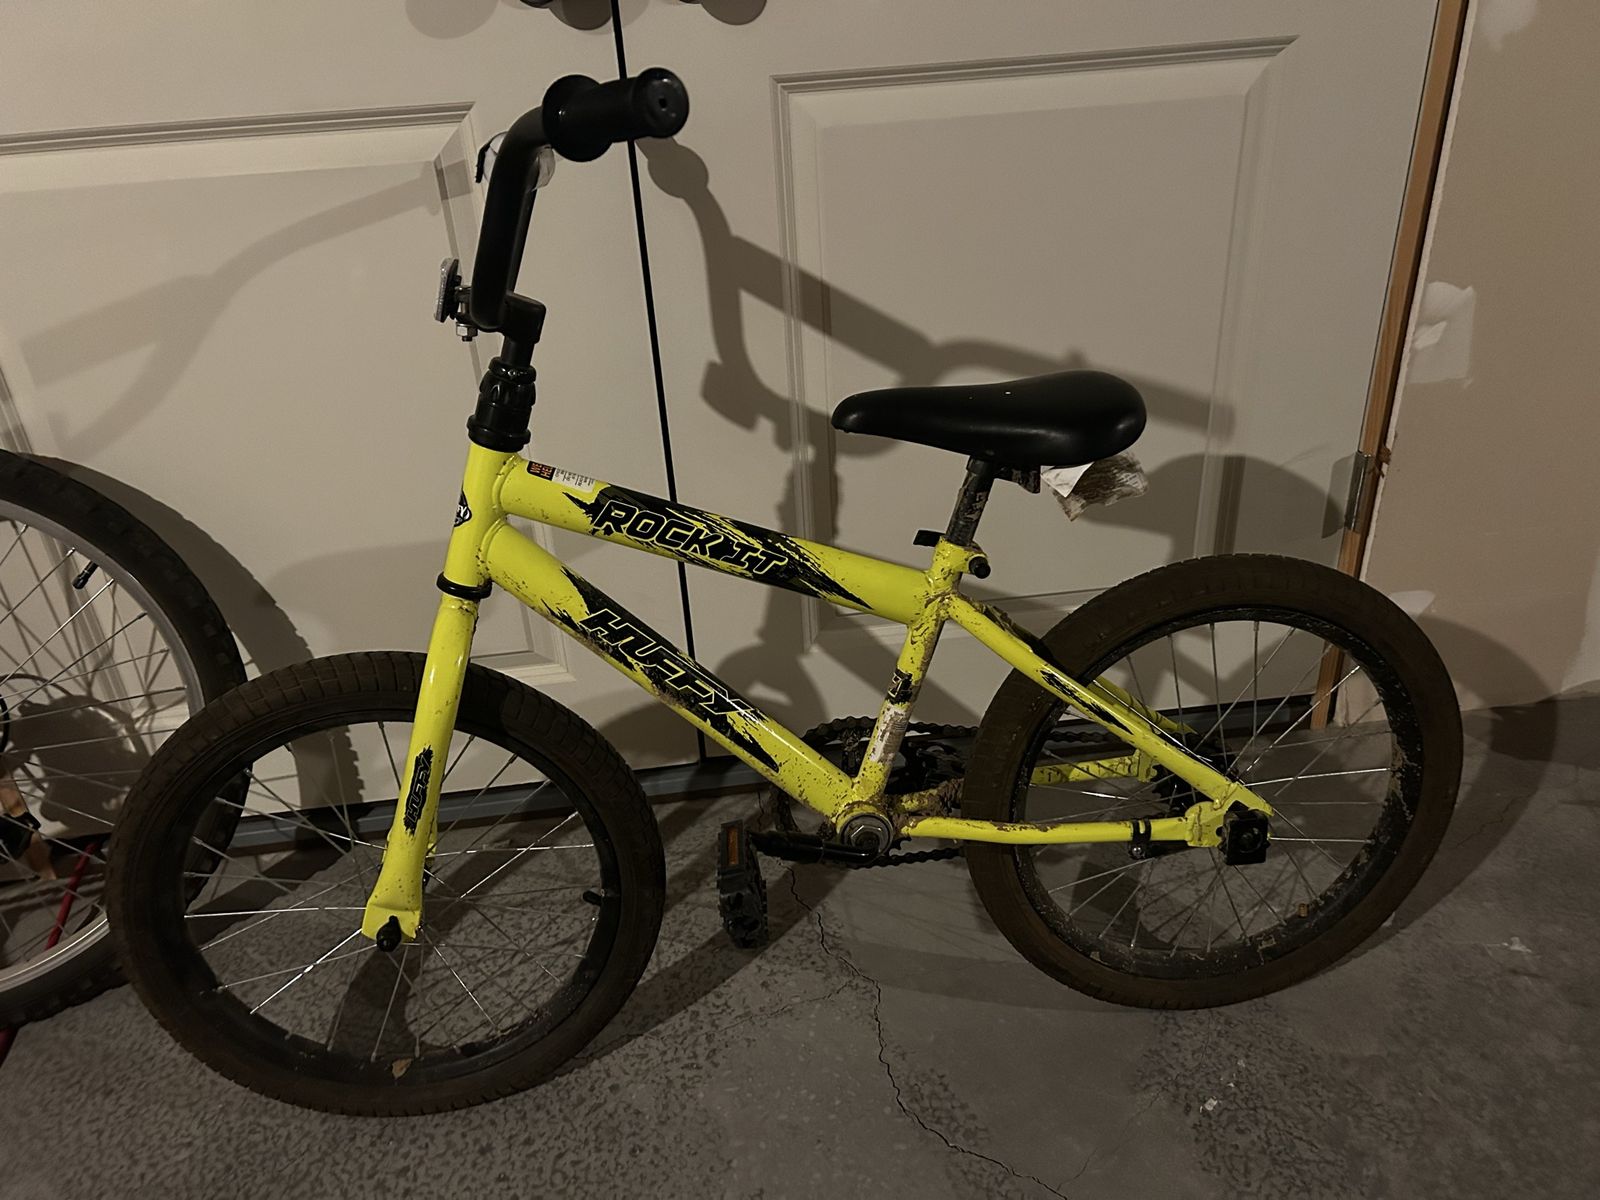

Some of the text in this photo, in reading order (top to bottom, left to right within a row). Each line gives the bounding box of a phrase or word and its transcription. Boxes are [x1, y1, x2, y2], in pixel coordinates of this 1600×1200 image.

[594, 499, 789, 575] ROCK IT
[578, 608, 755, 716] HUFFY
[406, 753, 431, 823] HUFFY
